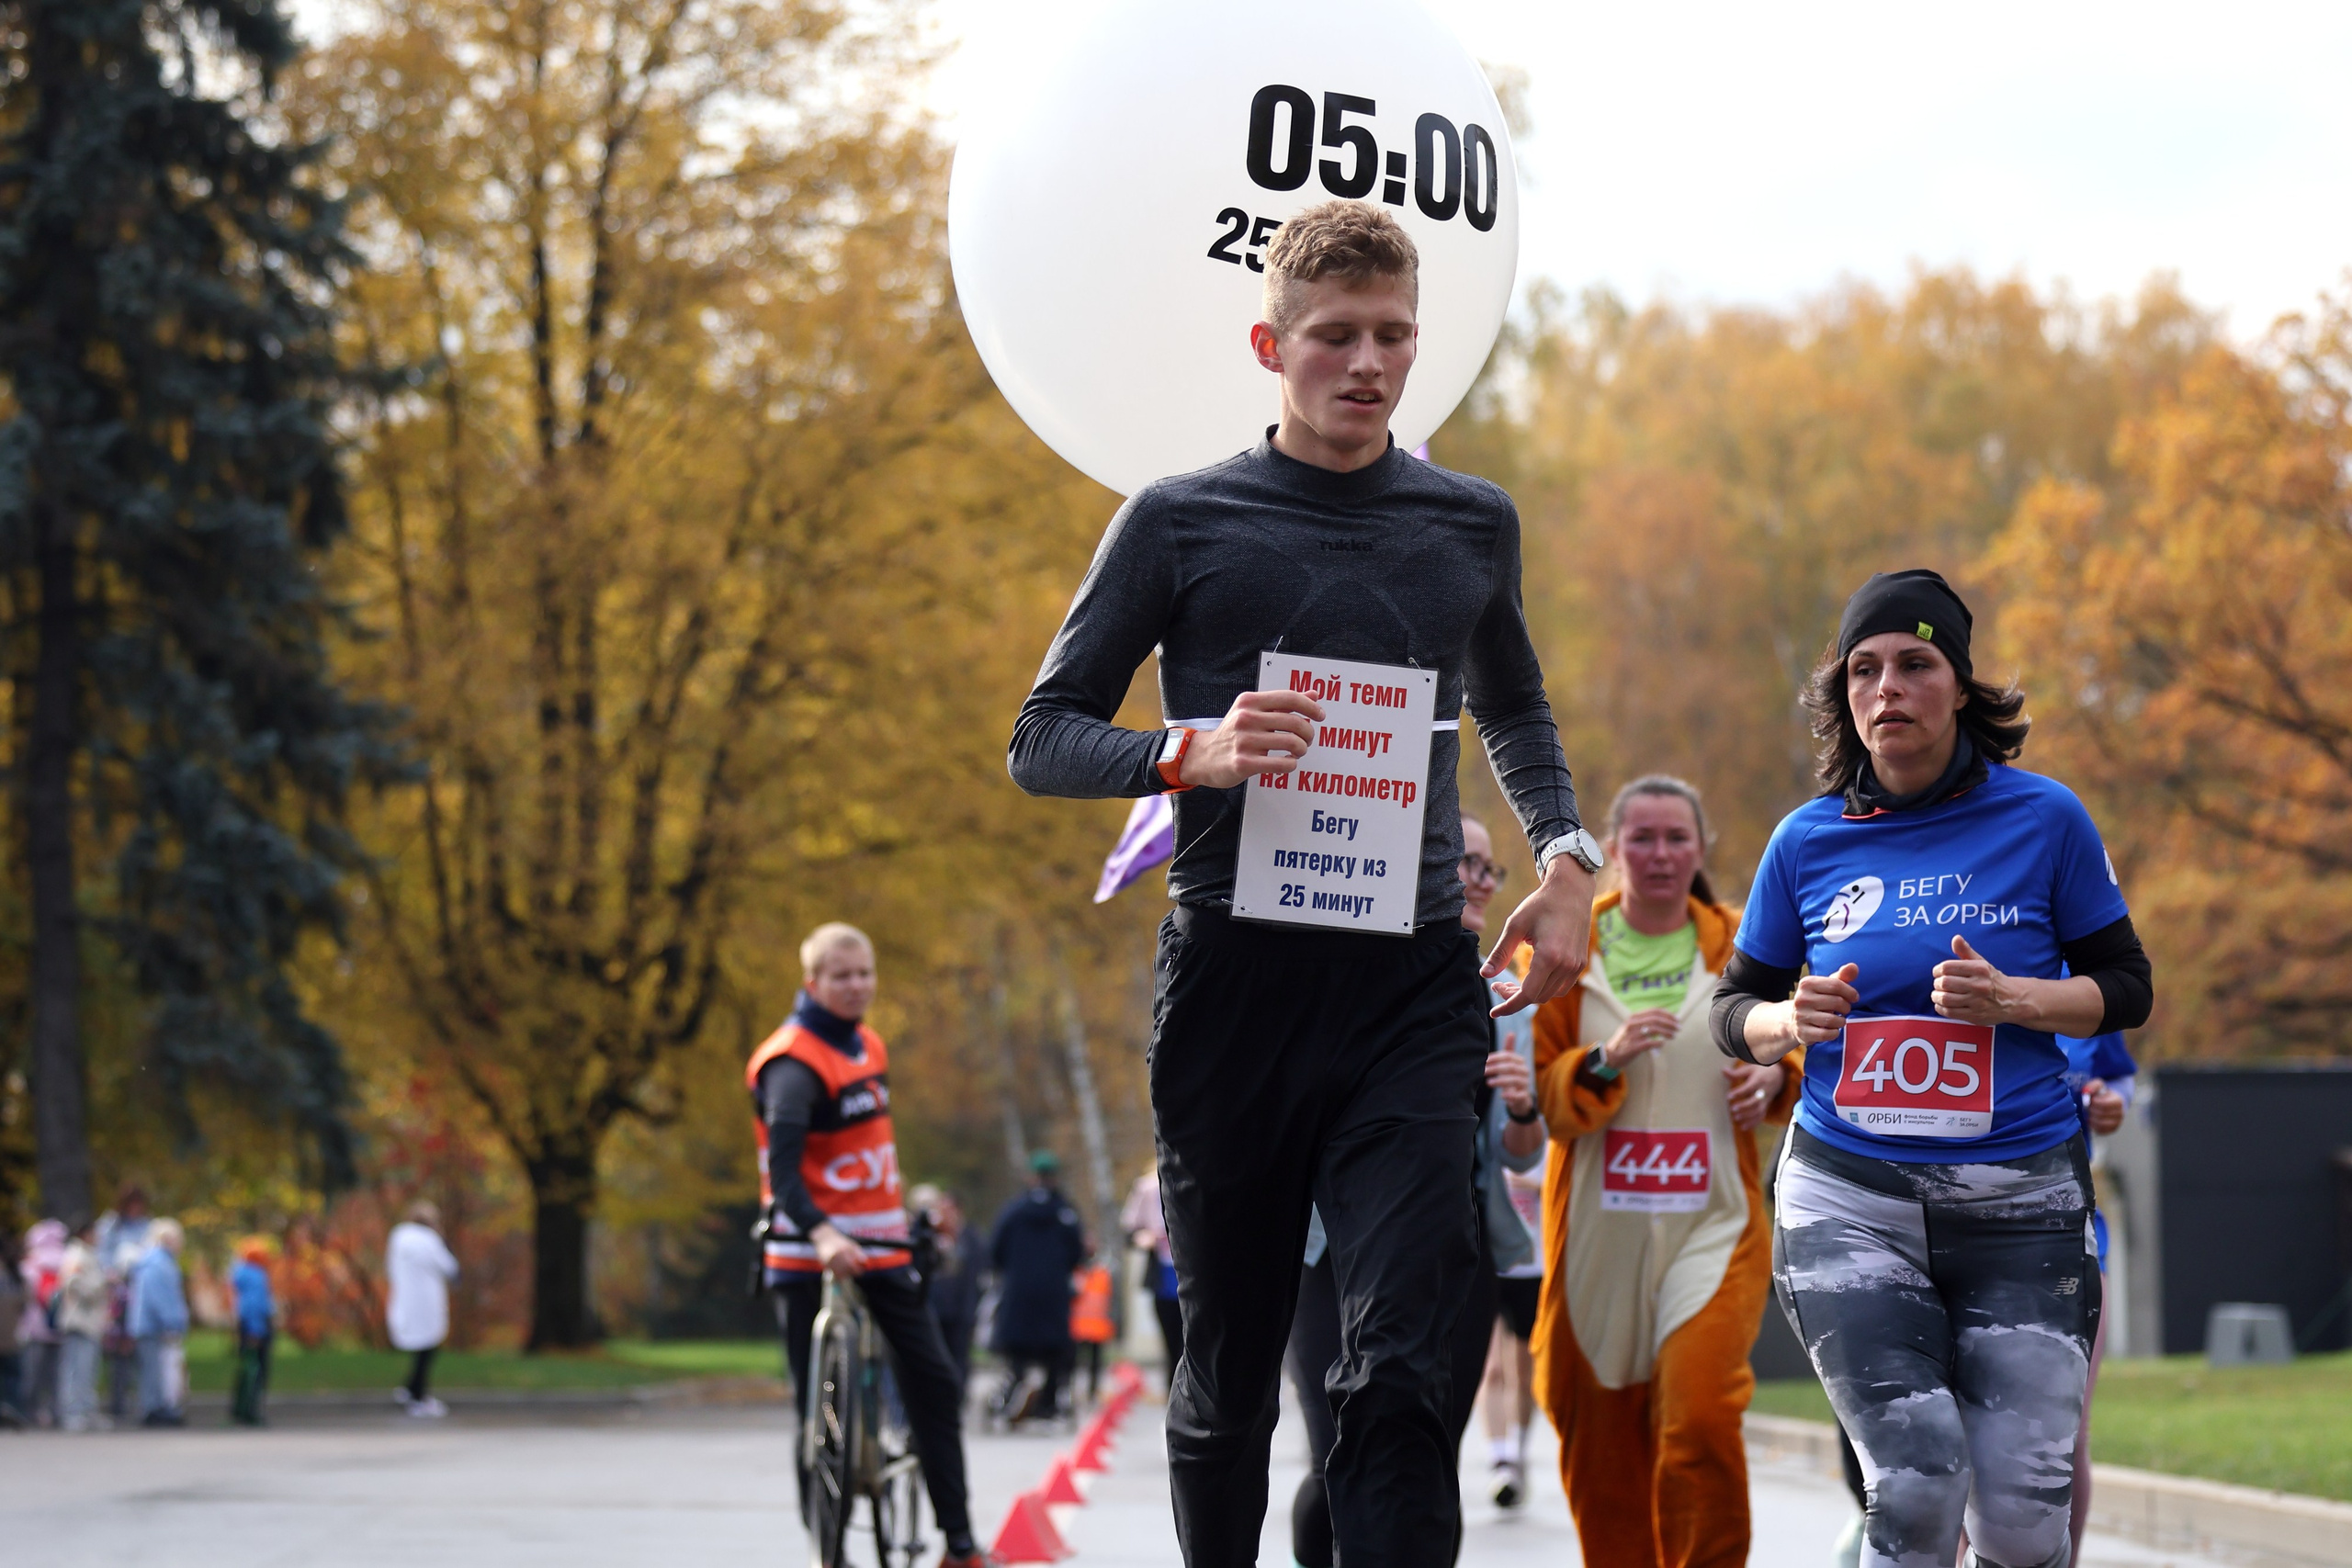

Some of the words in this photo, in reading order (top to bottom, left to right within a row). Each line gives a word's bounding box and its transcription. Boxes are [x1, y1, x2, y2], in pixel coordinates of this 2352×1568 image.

[1246, 84, 1498, 232] 05:00
[1206, 207, 1284, 274] 25
[1289, 669, 1342, 703] Мой
[1350, 682, 1408, 709] темп
[1318, 726, 1393, 759] минут
[1259, 771, 1290, 790] на
[1297, 770, 1417, 808] километр
[1311, 809, 1360, 841] Бегу
[1273, 849, 1357, 879] пятерку
[1363, 857, 1387, 878] из
[1279, 883, 1306, 908] 25
[1312, 891, 1375, 919] минут
[1898, 874, 1973, 899] БЕГУ
[1893, 906, 1930, 928] ЗА
[1936, 903, 2019, 926] ОРБИ
[1851, 1037, 1981, 1097] 405
[1867, 1112, 1902, 1124] ОРБИ
[1608, 1142, 1708, 1185] 444
